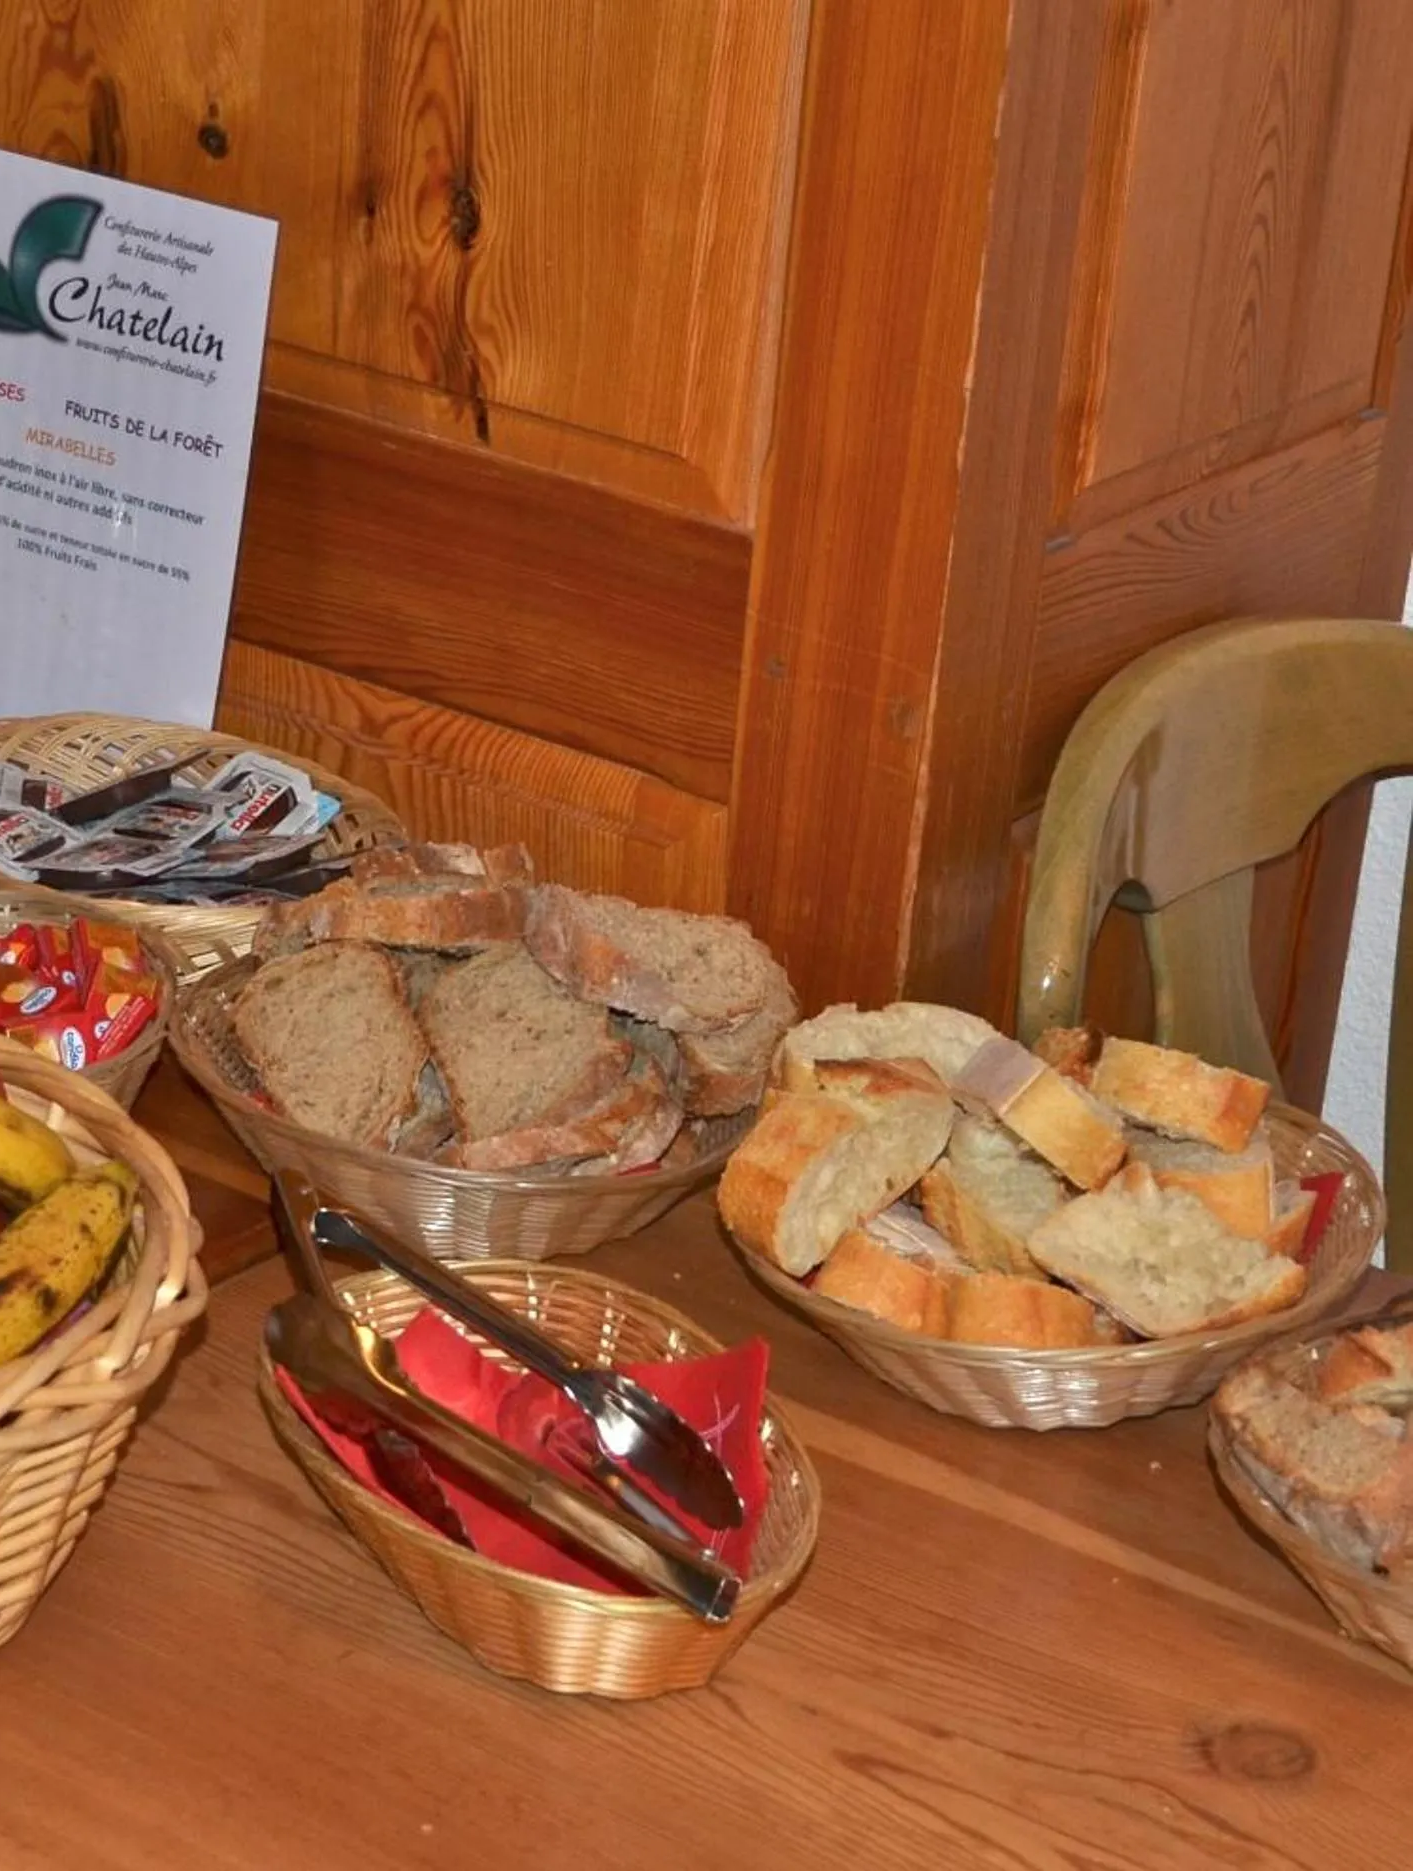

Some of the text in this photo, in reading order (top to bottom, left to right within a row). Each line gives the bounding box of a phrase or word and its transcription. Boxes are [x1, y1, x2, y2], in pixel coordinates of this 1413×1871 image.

[163, 231, 215, 256] Artisanale
[48, 276, 224, 362] Chatelain
[25, 426, 117, 467] MIRABELLES
[64, 399, 224, 459] FRUITS DE LA FORÊT
[55, 493, 90, 513] autres
[69, 473, 88, 492] l'air
[121, 491, 145, 509] sans
[147, 499, 205, 525] correcteur
[17, 536, 98, 571] 100% Fruits Frais
